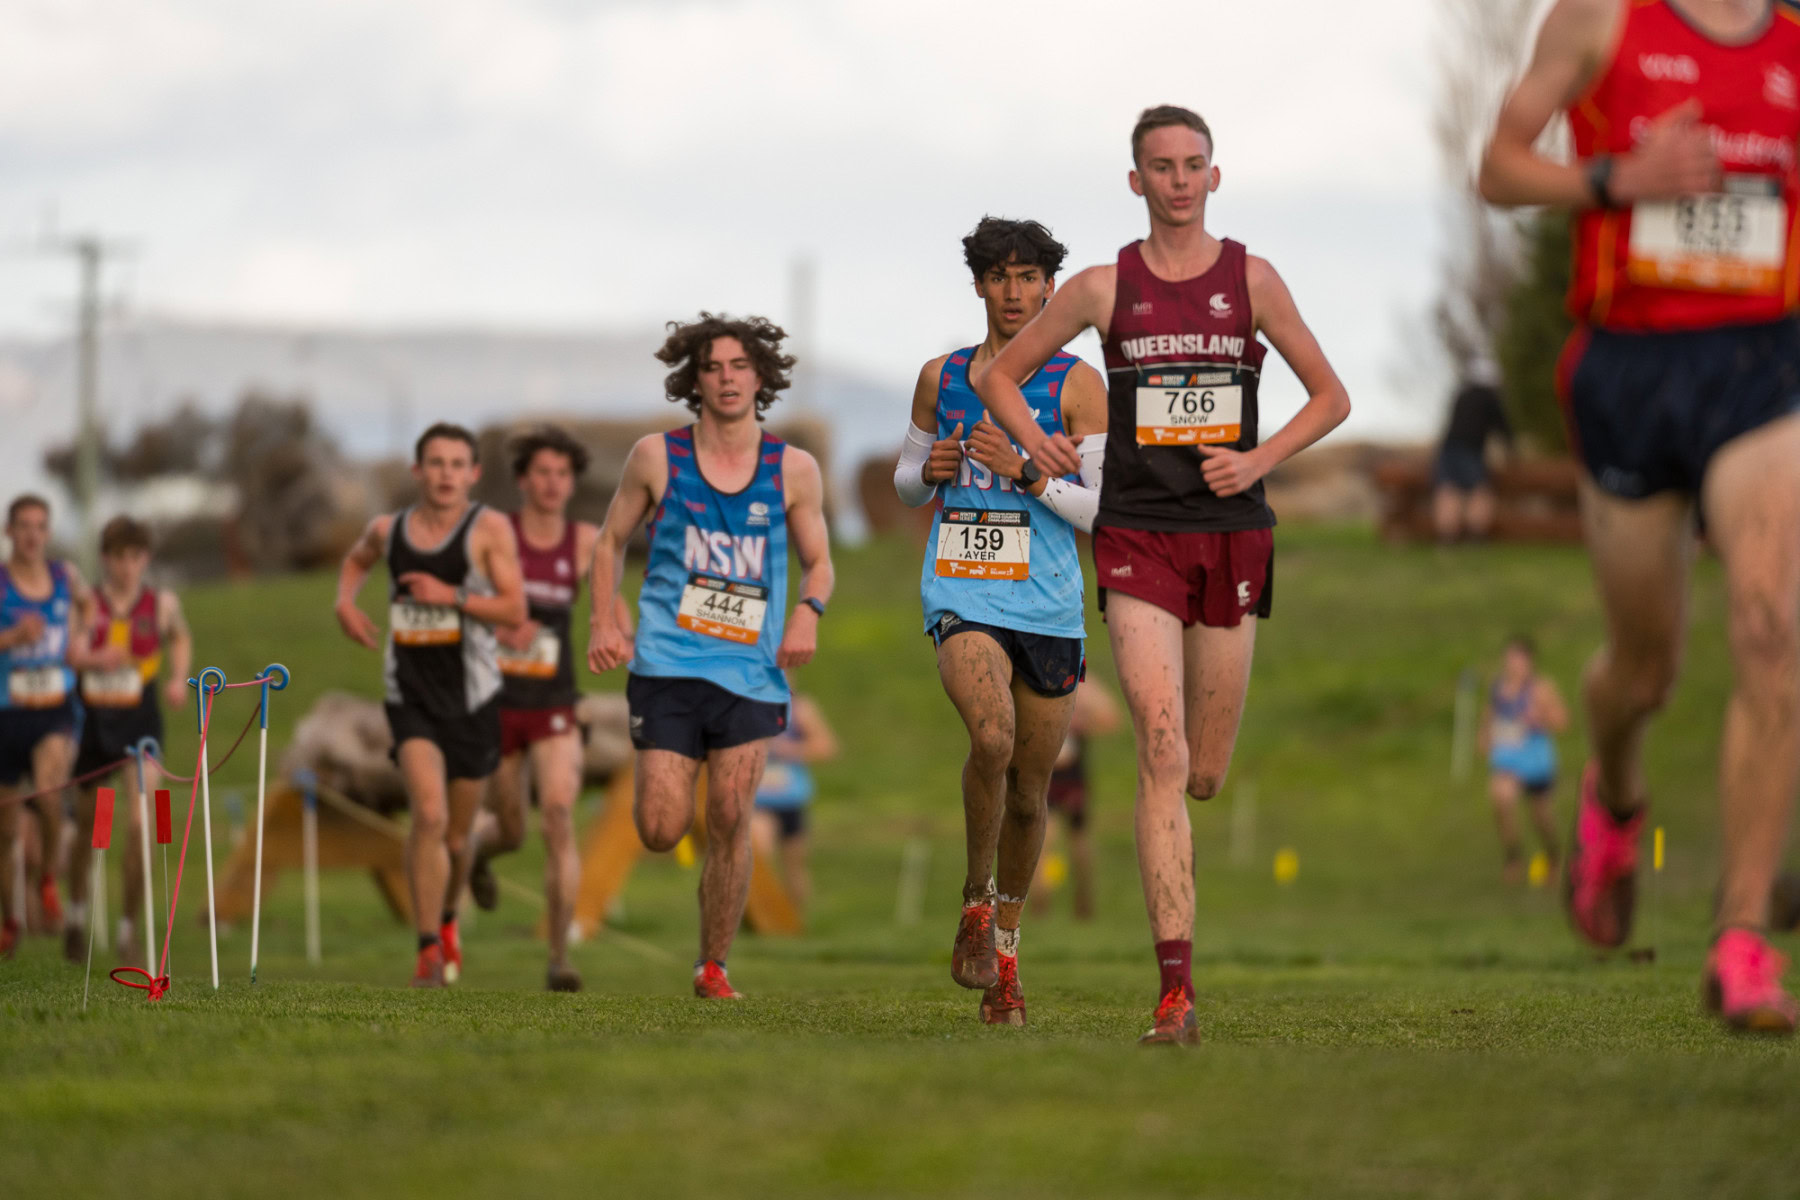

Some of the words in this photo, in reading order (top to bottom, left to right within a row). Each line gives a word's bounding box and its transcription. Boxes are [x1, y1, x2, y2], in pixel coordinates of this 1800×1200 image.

[1120, 334, 1246, 361] QUEENSLAND
[1164, 390, 1216, 414] 766
[1170, 414, 1209, 424] SNOW
[960, 527, 1004, 551] 159
[685, 526, 767, 580] NSW
[964, 550, 996, 561] AYER
[703, 593, 745, 617] 444
[696, 609, 746, 626] SHANNON
